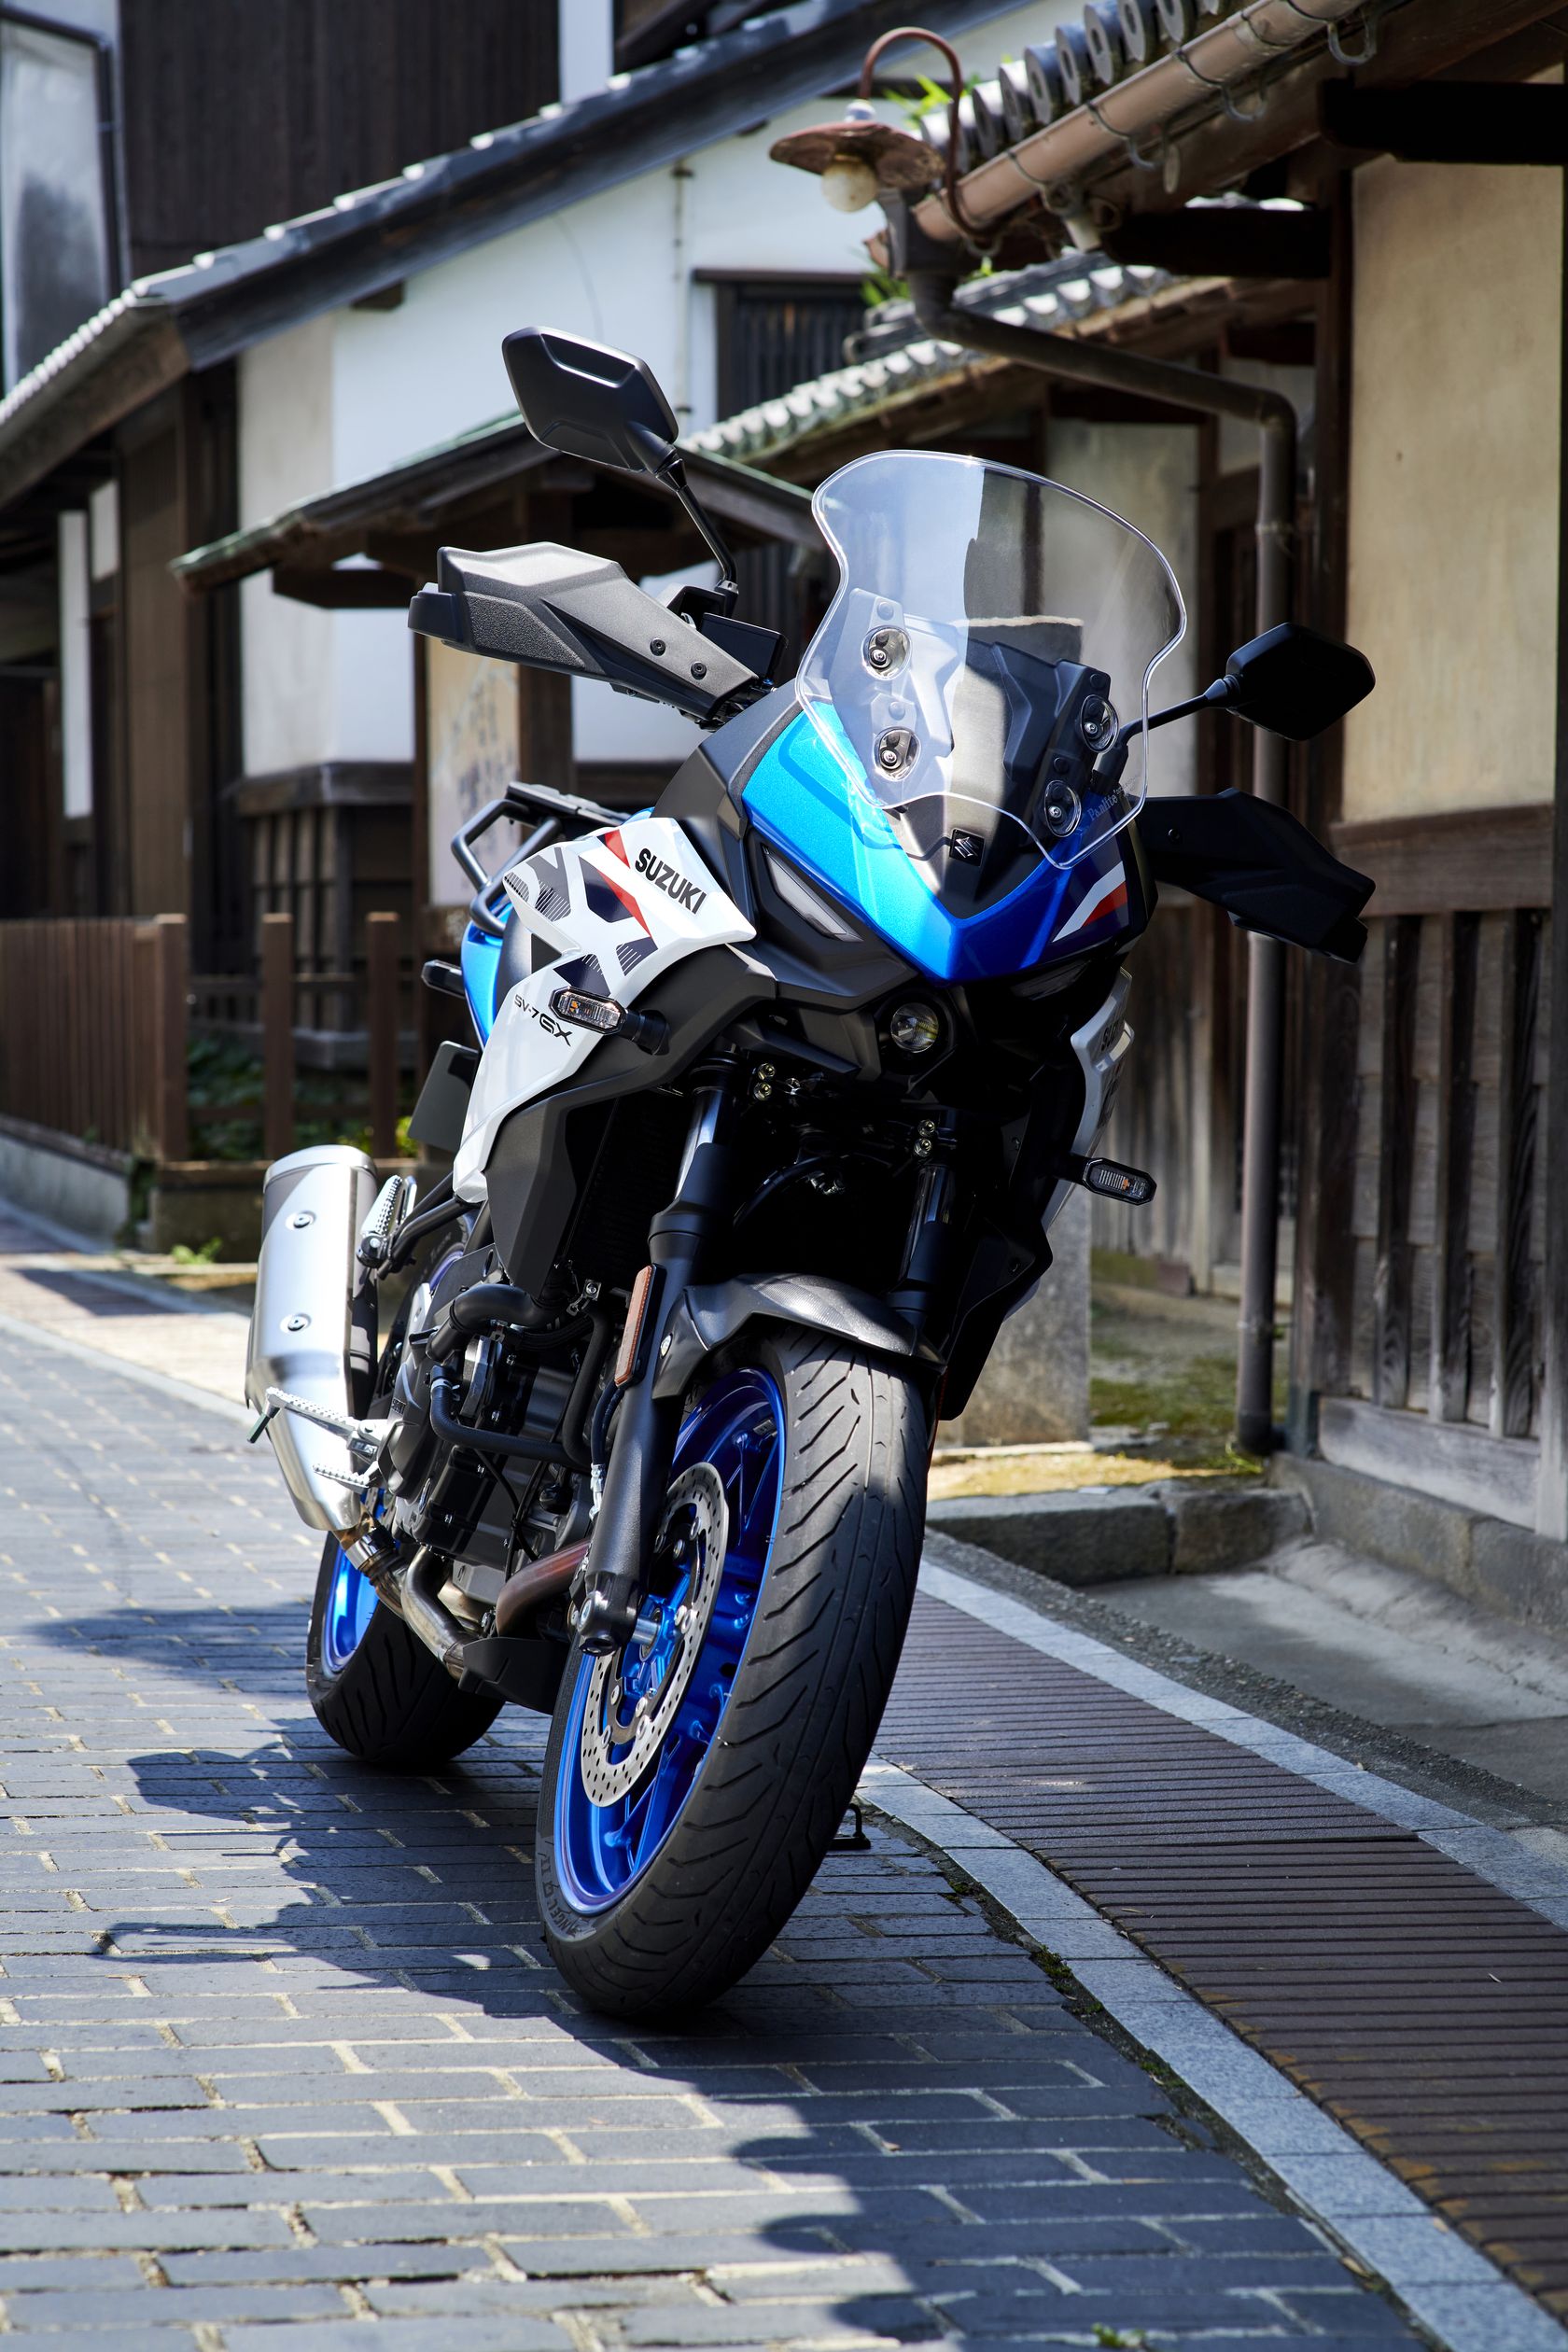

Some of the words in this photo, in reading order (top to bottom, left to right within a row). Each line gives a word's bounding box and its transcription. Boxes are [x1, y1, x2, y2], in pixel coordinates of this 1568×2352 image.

[1087, 794, 1118, 820] Panlite
[635, 847, 707, 915] SUZUKI
[514, 993, 572, 1046] SV-7GX
[547, 1898, 579, 1938] ANGEL
